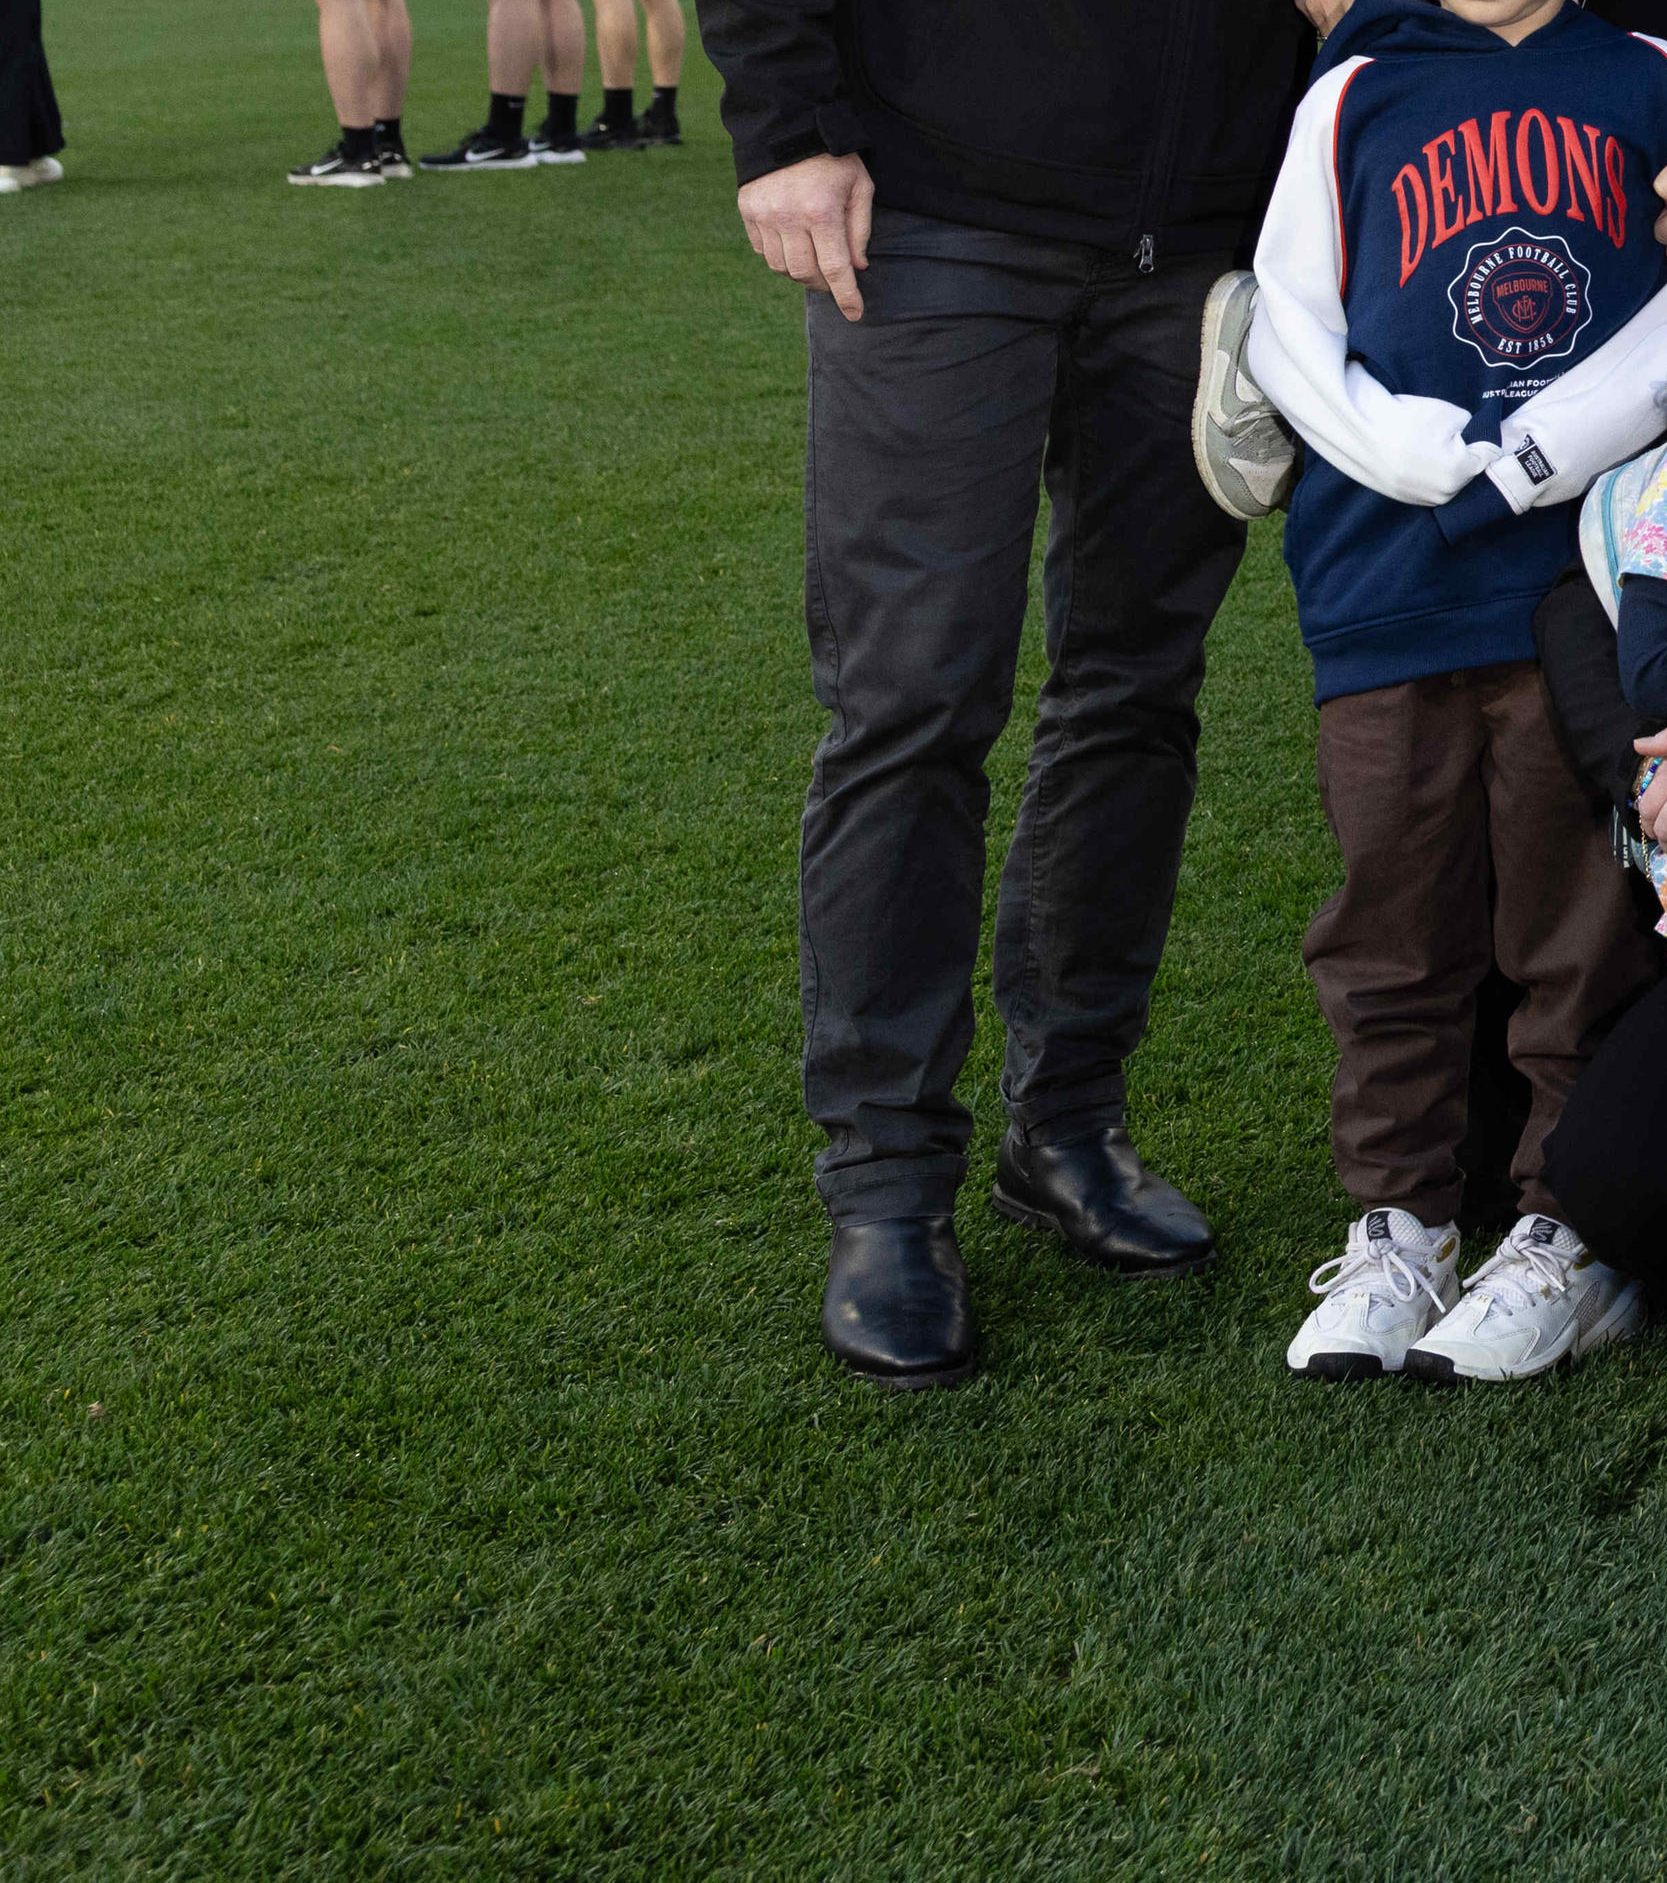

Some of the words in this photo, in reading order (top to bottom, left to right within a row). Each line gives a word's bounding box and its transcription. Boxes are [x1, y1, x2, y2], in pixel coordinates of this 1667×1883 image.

[1391, 108, 1627, 289] DEMONS
[1467, 252, 1503, 325] MELBOURNE
[1508, 246, 1569, 279] FOOTBALL
[1564, 283, 1578, 315] CLUB
[1496, 279, 1549, 297] MELBOURNE
[1497, 338, 1522, 354] EST
[1528, 333, 1554, 353] 1858
